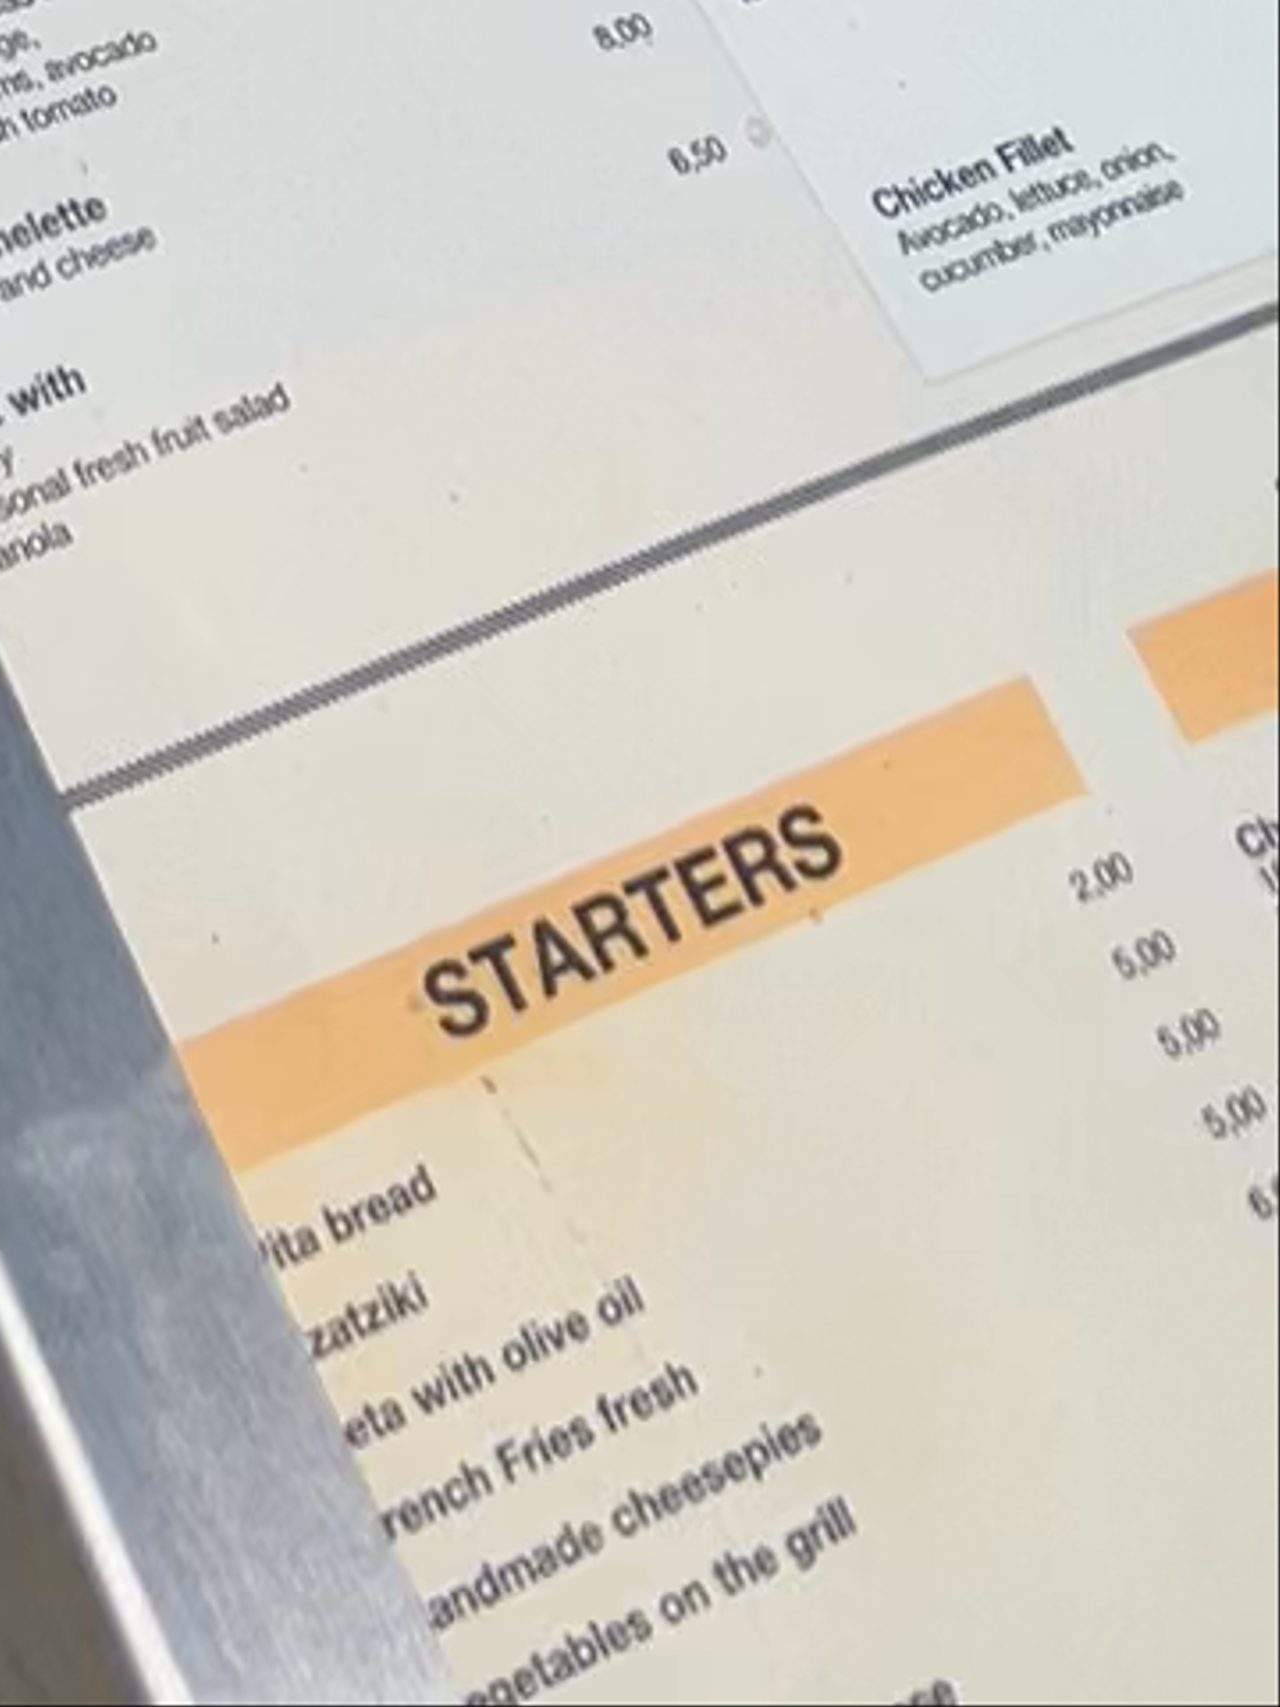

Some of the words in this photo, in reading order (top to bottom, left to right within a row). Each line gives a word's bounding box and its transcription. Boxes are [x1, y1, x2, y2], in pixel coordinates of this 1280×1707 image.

[871, 158, 997, 219] Chicken
[993, 125, 1074, 174] Fillet
[7, 365, 86, 416] with
[422, 804, 842, 1037] STARTERS
[1068, 851, 1133, 903] 2,00
[1110, 928, 1176, 980] 5,00
[1156, 1007, 1220, 1060] 5,00
[1201, 1085, 1267, 1139] 5,00
[321, 1162, 436, 1244] bread
[344, 1398, 407, 1449] eta
[410, 1352, 496, 1415] with
[501, 1310, 590, 1372] olive
[596, 1275, 644, 1326] oil
[494, 1415, 595, 1484] Fries
[595, 1362, 698, 1434] fresh
[610, 1413, 822, 1538] cheesepies
[658, 1579, 711, 1626] on
[711, 1544, 779, 1596] the
[784, 1495, 857, 1571] grill
